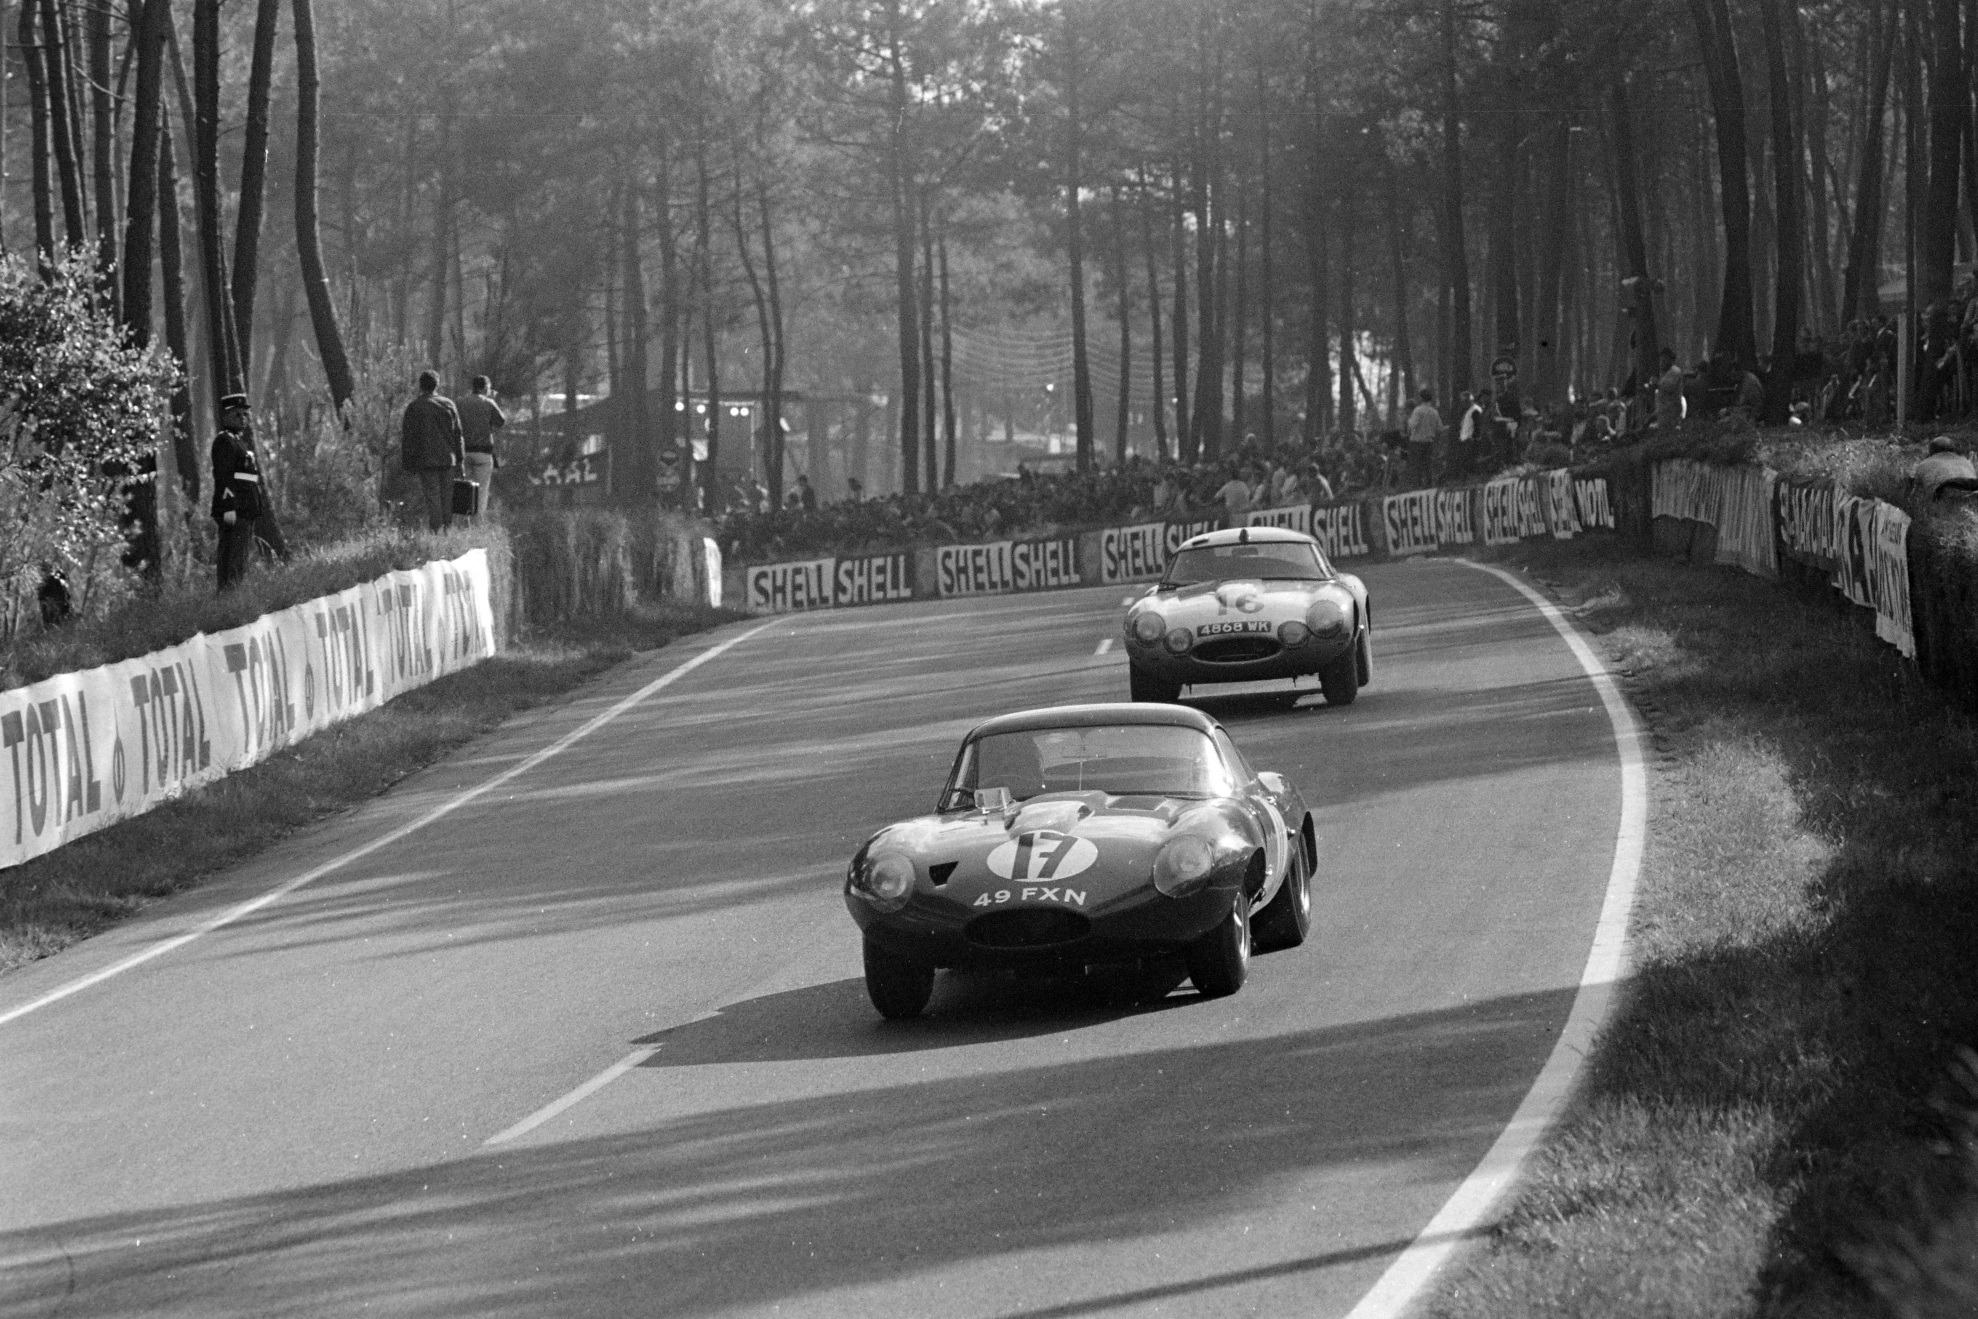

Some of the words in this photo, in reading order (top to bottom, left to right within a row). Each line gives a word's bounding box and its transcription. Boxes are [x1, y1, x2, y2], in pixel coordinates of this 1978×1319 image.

[1314, 505, 1369, 556] SHELL
[1387, 490, 1437, 550] SHELL
[1438, 491, 1473, 541] SHELL
[941, 546, 1012, 596] SHELL
[1014, 539, 1081, 589] SHELL
[1103, 525, 1165, 579] SHELL
[753, 563, 831, 610] SHELL
[838, 554, 912, 604] SHELL
[1217, 592, 1264, 616] 16
[316, 597, 374, 711] TOTAL
[378, 583, 432, 682] TOTAL
[1201, 622, 1243, 635] 4868
[1248, 622, 1268, 633] WK
[224, 627, 295, 753] TOTAL
[130, 658, 210, 795] TOTAL
[2, 690, 101, 845] TOTAL
[1011, 830, 1079, 880] 17
[973, 889, 1011, 907] 49
[1022, 887, 1087, 906] FXN
